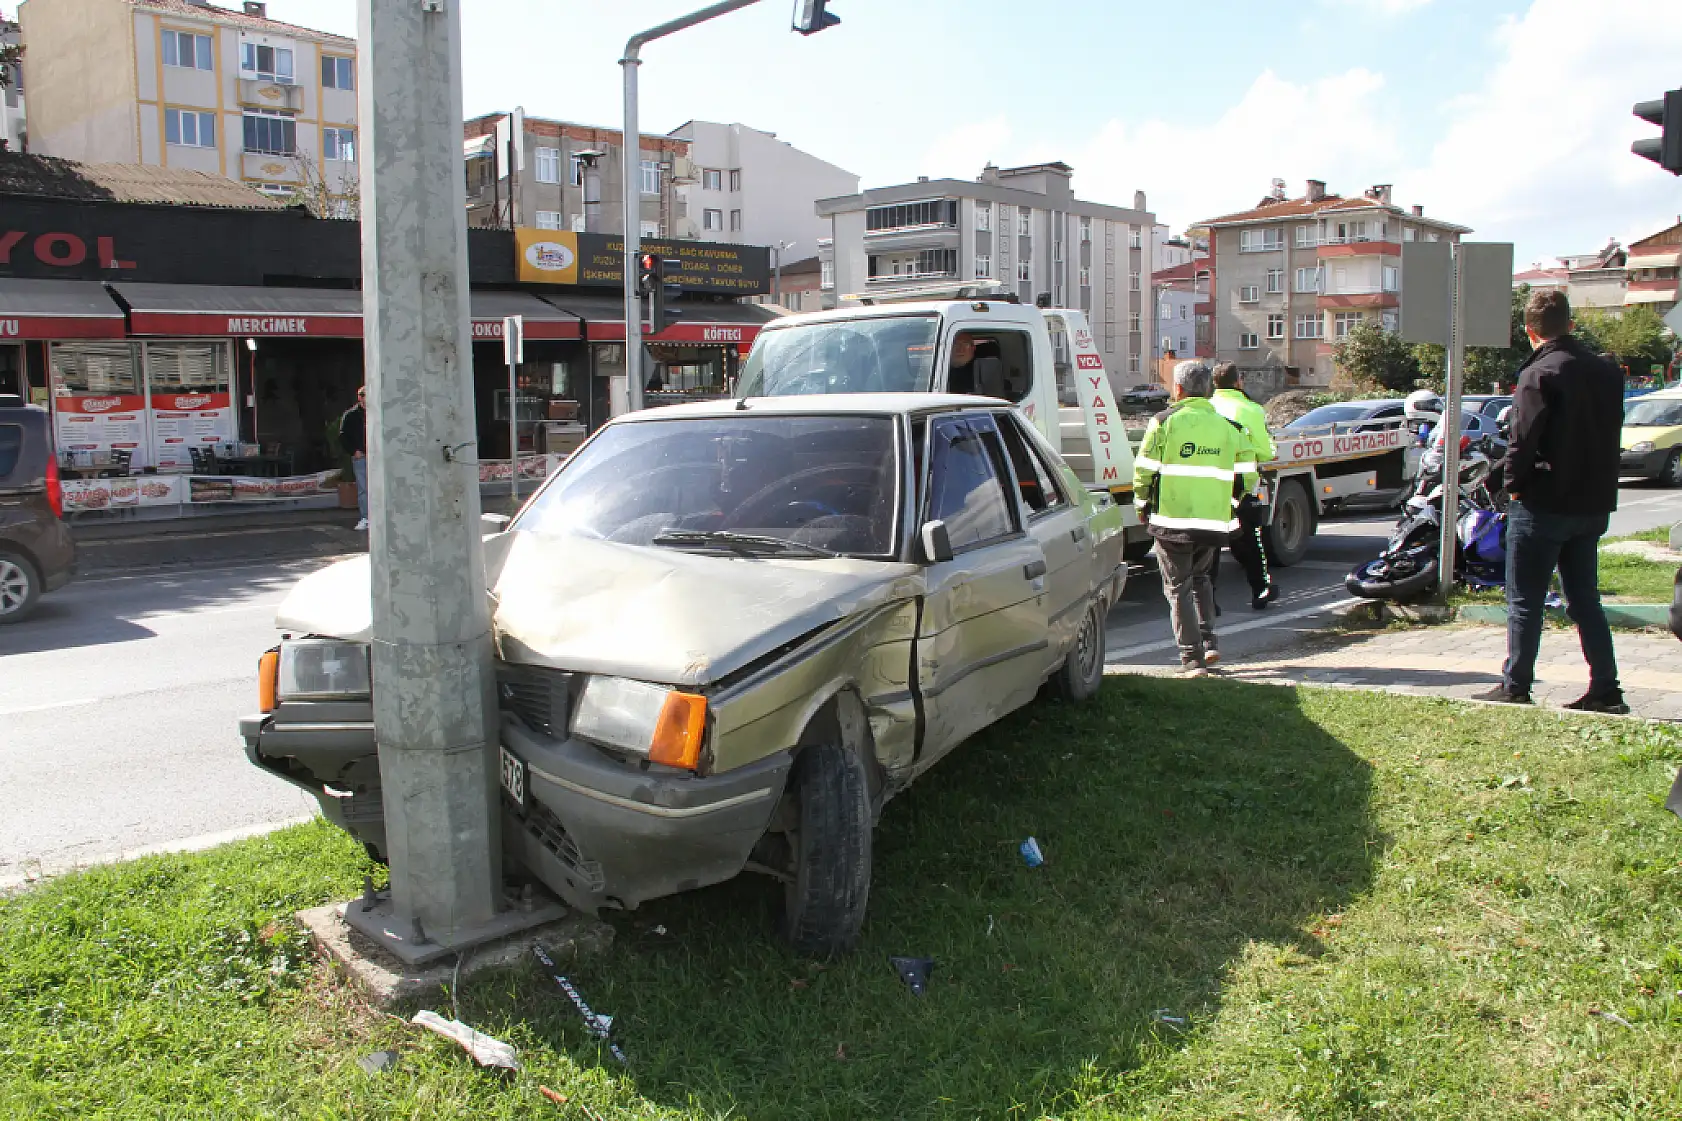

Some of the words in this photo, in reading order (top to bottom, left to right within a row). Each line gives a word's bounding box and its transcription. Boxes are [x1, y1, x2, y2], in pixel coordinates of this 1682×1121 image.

[0, 231, 137, 269] YOL
[606, 242, 625, 251] KUZ
[1078, 356, 1101, 368] YOL
[1088, 377, 1118, 480] YARDIM
[1292, 441, 1323, 458] OTO
[1333, 431, 1399, 454] KURTARICI
